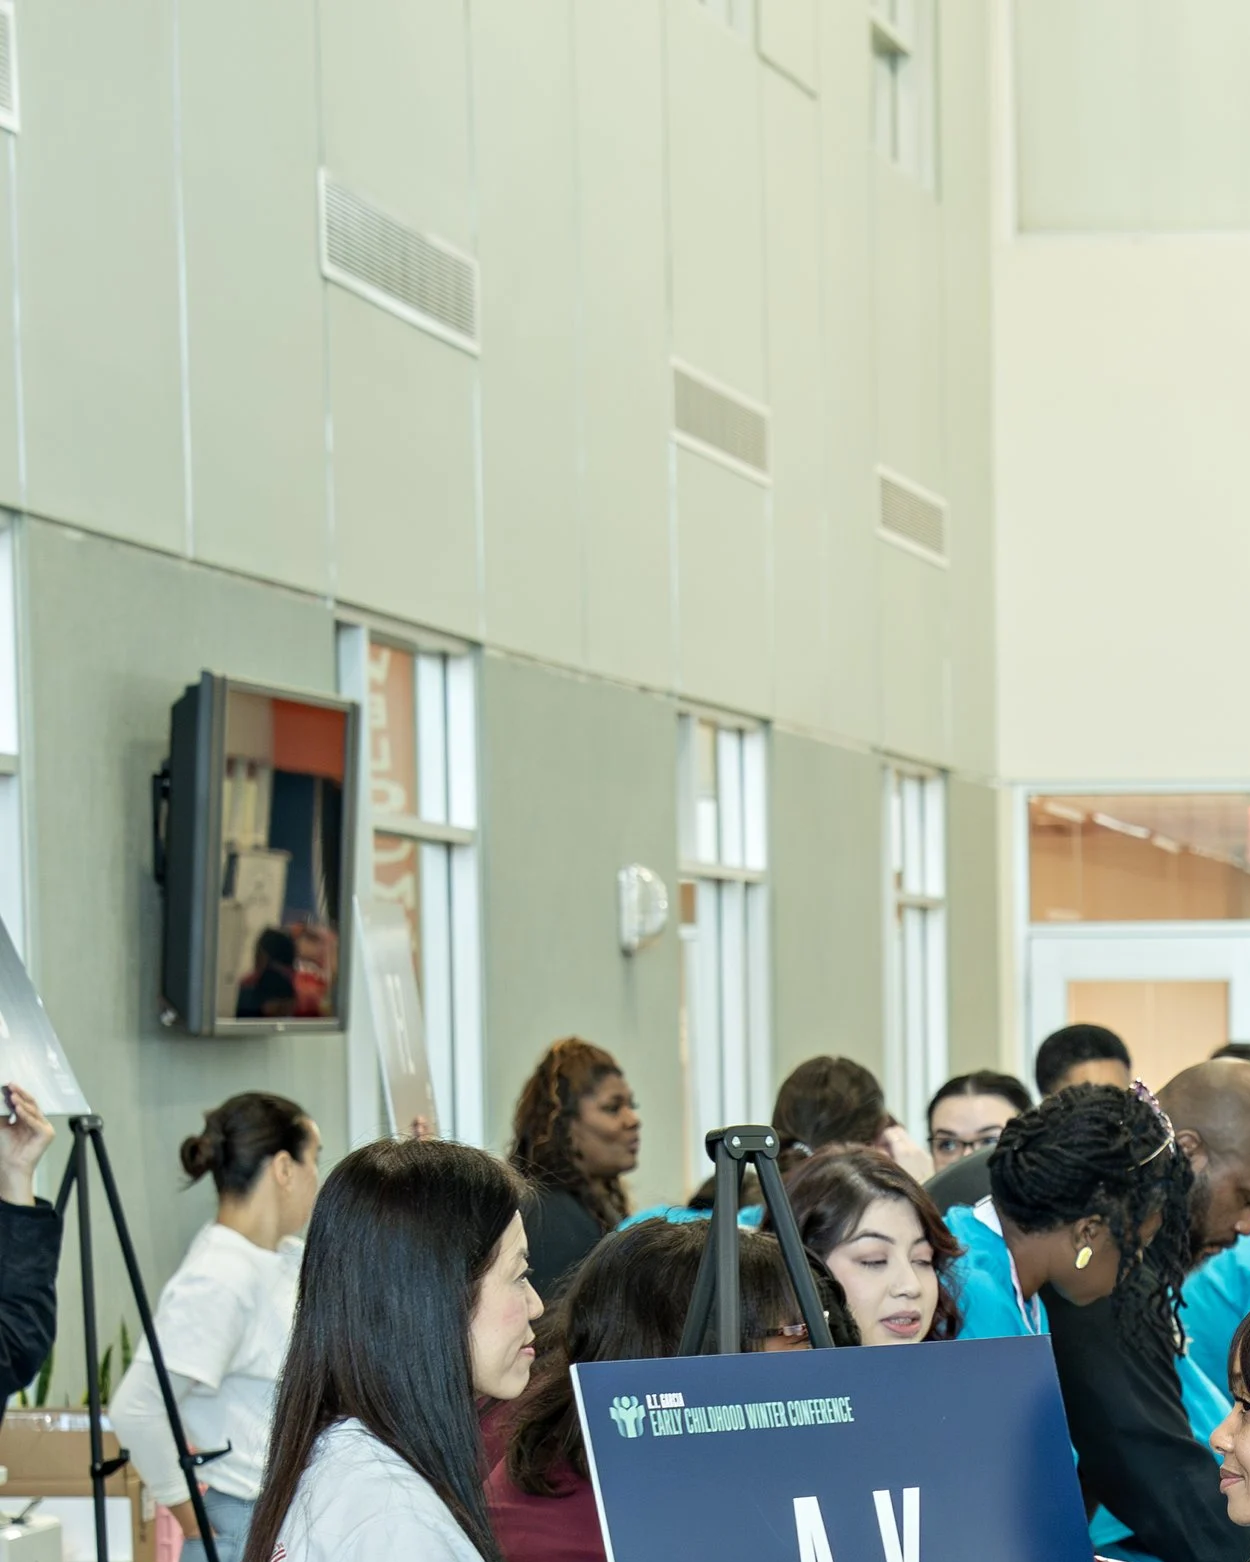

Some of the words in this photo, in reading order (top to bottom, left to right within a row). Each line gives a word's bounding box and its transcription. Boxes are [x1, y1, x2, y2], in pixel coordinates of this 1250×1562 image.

[649, 1408, 683, 1437] EARLY
[684, 1404, 746, 1434] CHILDHOOD
[744, 1401, 789, 1430] WINTER
[787, 1397, 854, 1426] CONFERENCE
